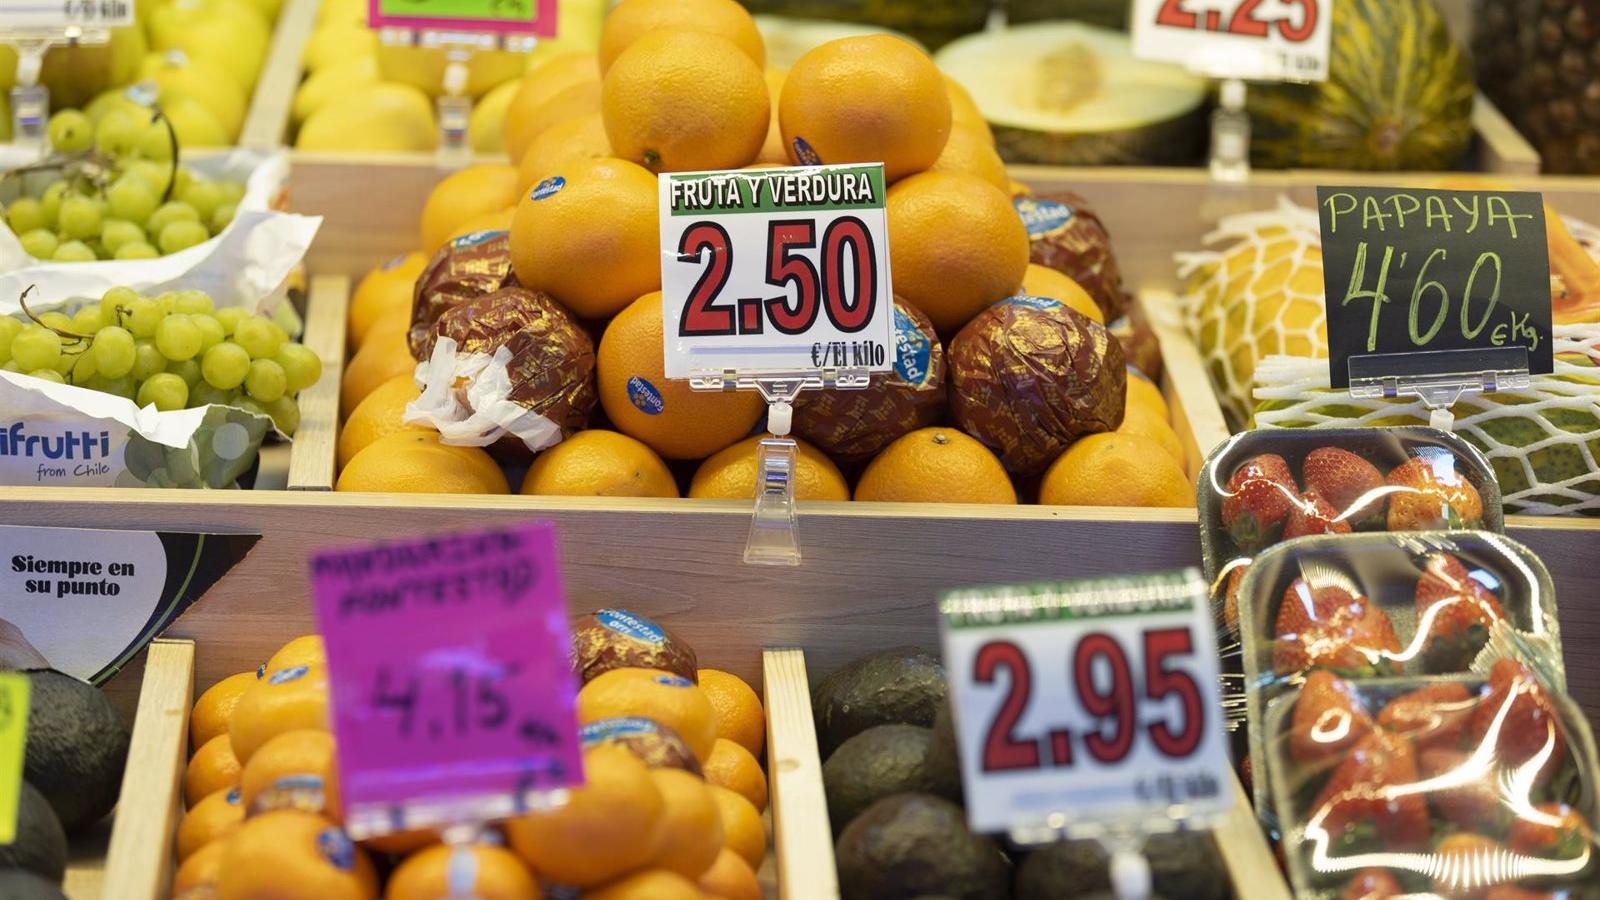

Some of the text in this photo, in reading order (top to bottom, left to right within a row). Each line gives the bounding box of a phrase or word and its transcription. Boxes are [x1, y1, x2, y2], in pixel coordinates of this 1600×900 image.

[671, 173, 875, 208] FRUTA Y VERDURA
[1324, 193, 1535, 239] PAPAYA
[677, 215, 878, 337] 2.50
[852, 340, 885, 366] kilo
[37, 462, 110, 481] from Chile
[11, 555, 135, 578] Siempre en
[25, 578, 120, 598] su punto
[373, 664, 516, 738] 4.15
[972, 627, 1206, 774] 2.95
